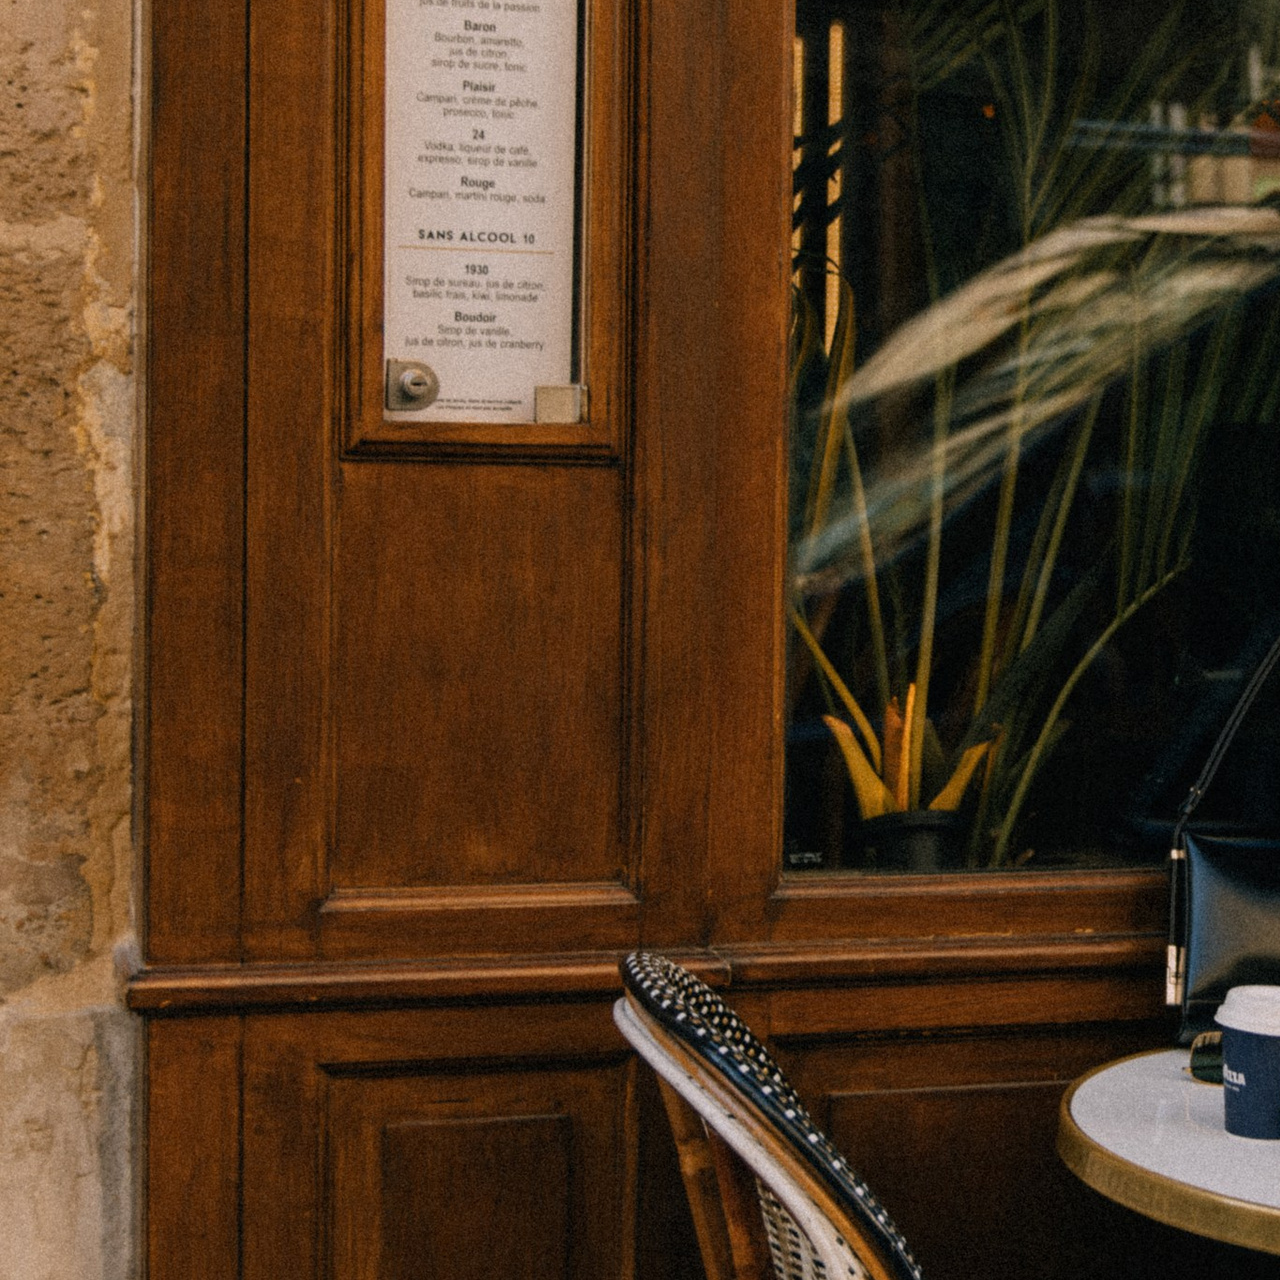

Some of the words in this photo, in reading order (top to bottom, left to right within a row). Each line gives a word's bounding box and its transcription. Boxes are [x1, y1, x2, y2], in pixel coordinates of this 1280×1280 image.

[463, 19, 496, 32] Baron
[462, 80, 495, 92] Plaisir
[472, 129, 484, 140] 24
[461, 176, 495, 190] Rouge
[522, 194, 545, 202] soda
[418, 228, 453, 240] SANS
[459, 230, 515, 243] ALCOOL
[523, 233, 535, 244] 10
[464, 264, 488, 274] 1930
[454, 311, 496, 322] Boudoir
